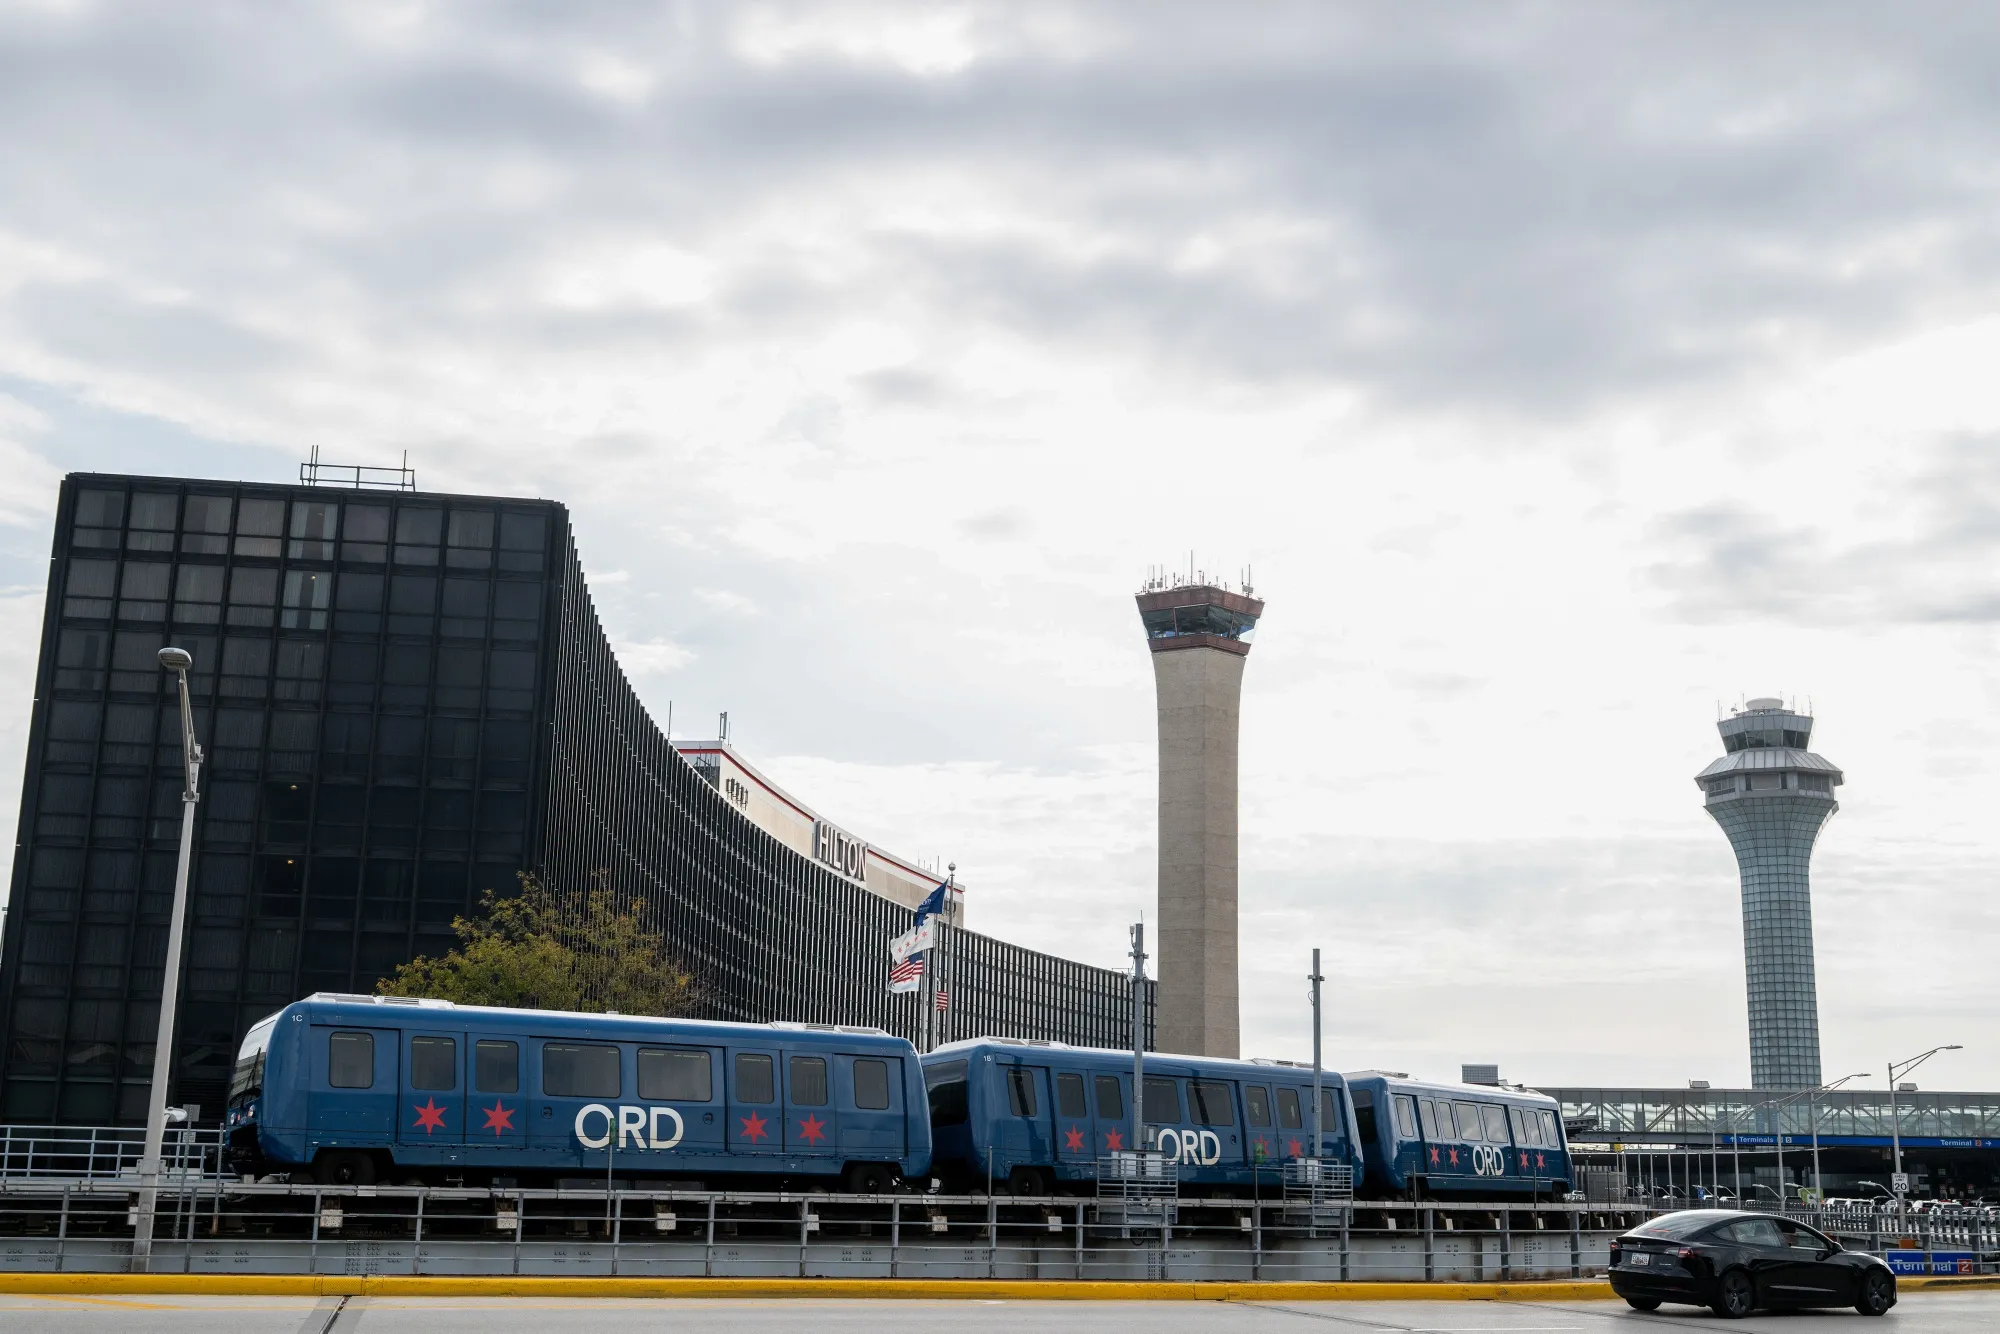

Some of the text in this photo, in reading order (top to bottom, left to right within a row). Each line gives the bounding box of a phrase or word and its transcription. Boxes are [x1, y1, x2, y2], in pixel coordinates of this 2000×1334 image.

[815, 821, 868, 881] HILTON
[291, 1014, 303, 1022] 1C
[575, 1104, 684, 1149] ORD
[1158, 1128, 1221, 1165] ORD
[1473, 1145, 1504, 1176] ORD
[1894, 1259, 1970, 1272] Termnal 2
